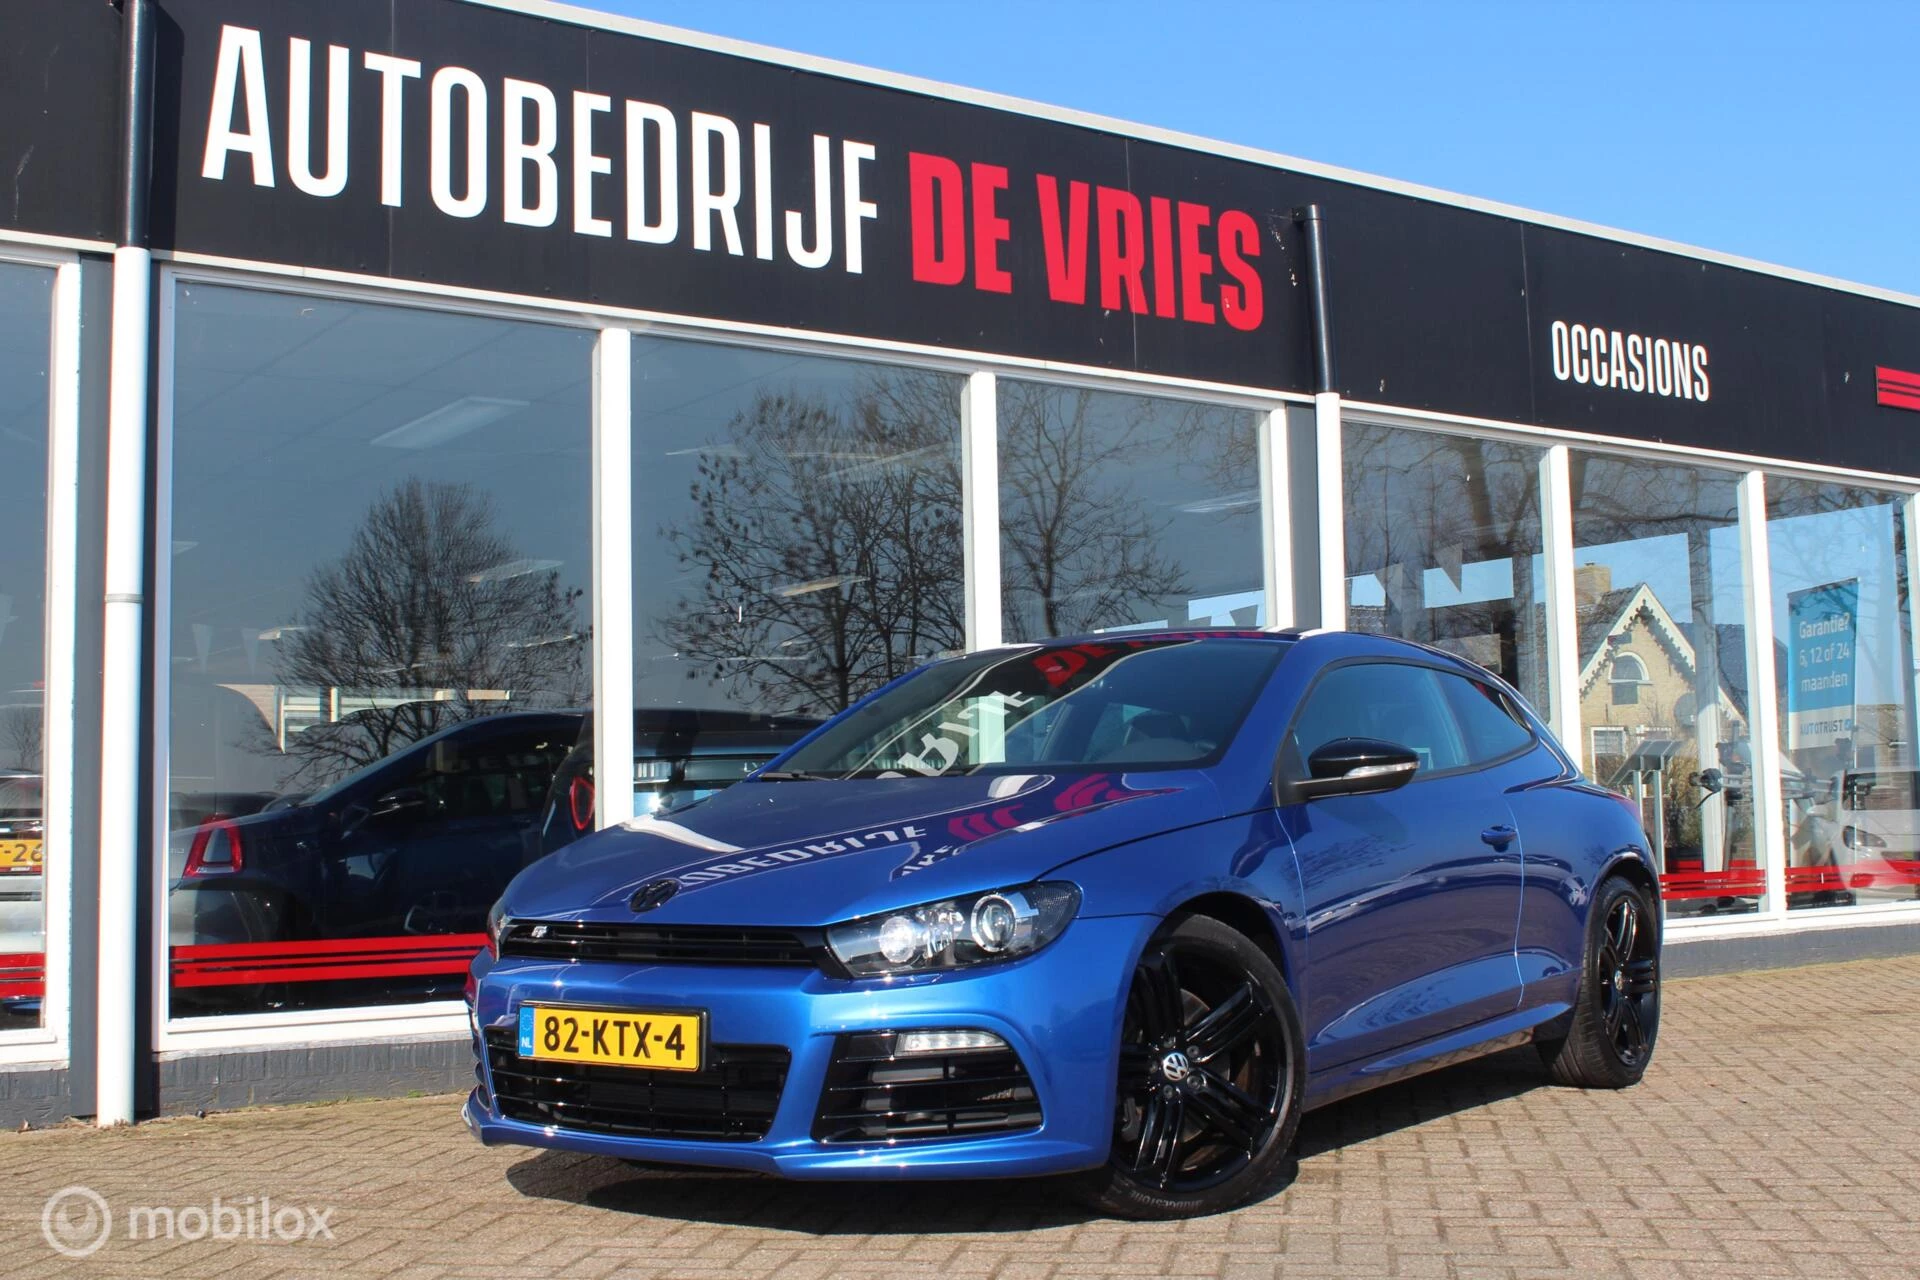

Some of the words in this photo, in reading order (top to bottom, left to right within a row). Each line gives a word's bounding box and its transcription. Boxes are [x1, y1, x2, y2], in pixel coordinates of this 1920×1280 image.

[202, 25, 878, 274] AUTOBEDRIJF
[909, 151, 1012, 295] DE
[1036, 173, 1264, 332] VRIES
[1551, 320, 1710, 402] OCCASIONS
[1800, 612, 1850, 639] Garantie?
[1811, 646, 1823, 664] 12
[1824, 643, 1835, 661] of
[1836, 642, 1850, 660] 24
[1801, 671, 1848, 692] maanden
[1801, 720, 1843, 735] AUTOTRUST
[521, 1037, 532, 1047] NL
[544, 1016, 685, 1060] 82-KTX-4
